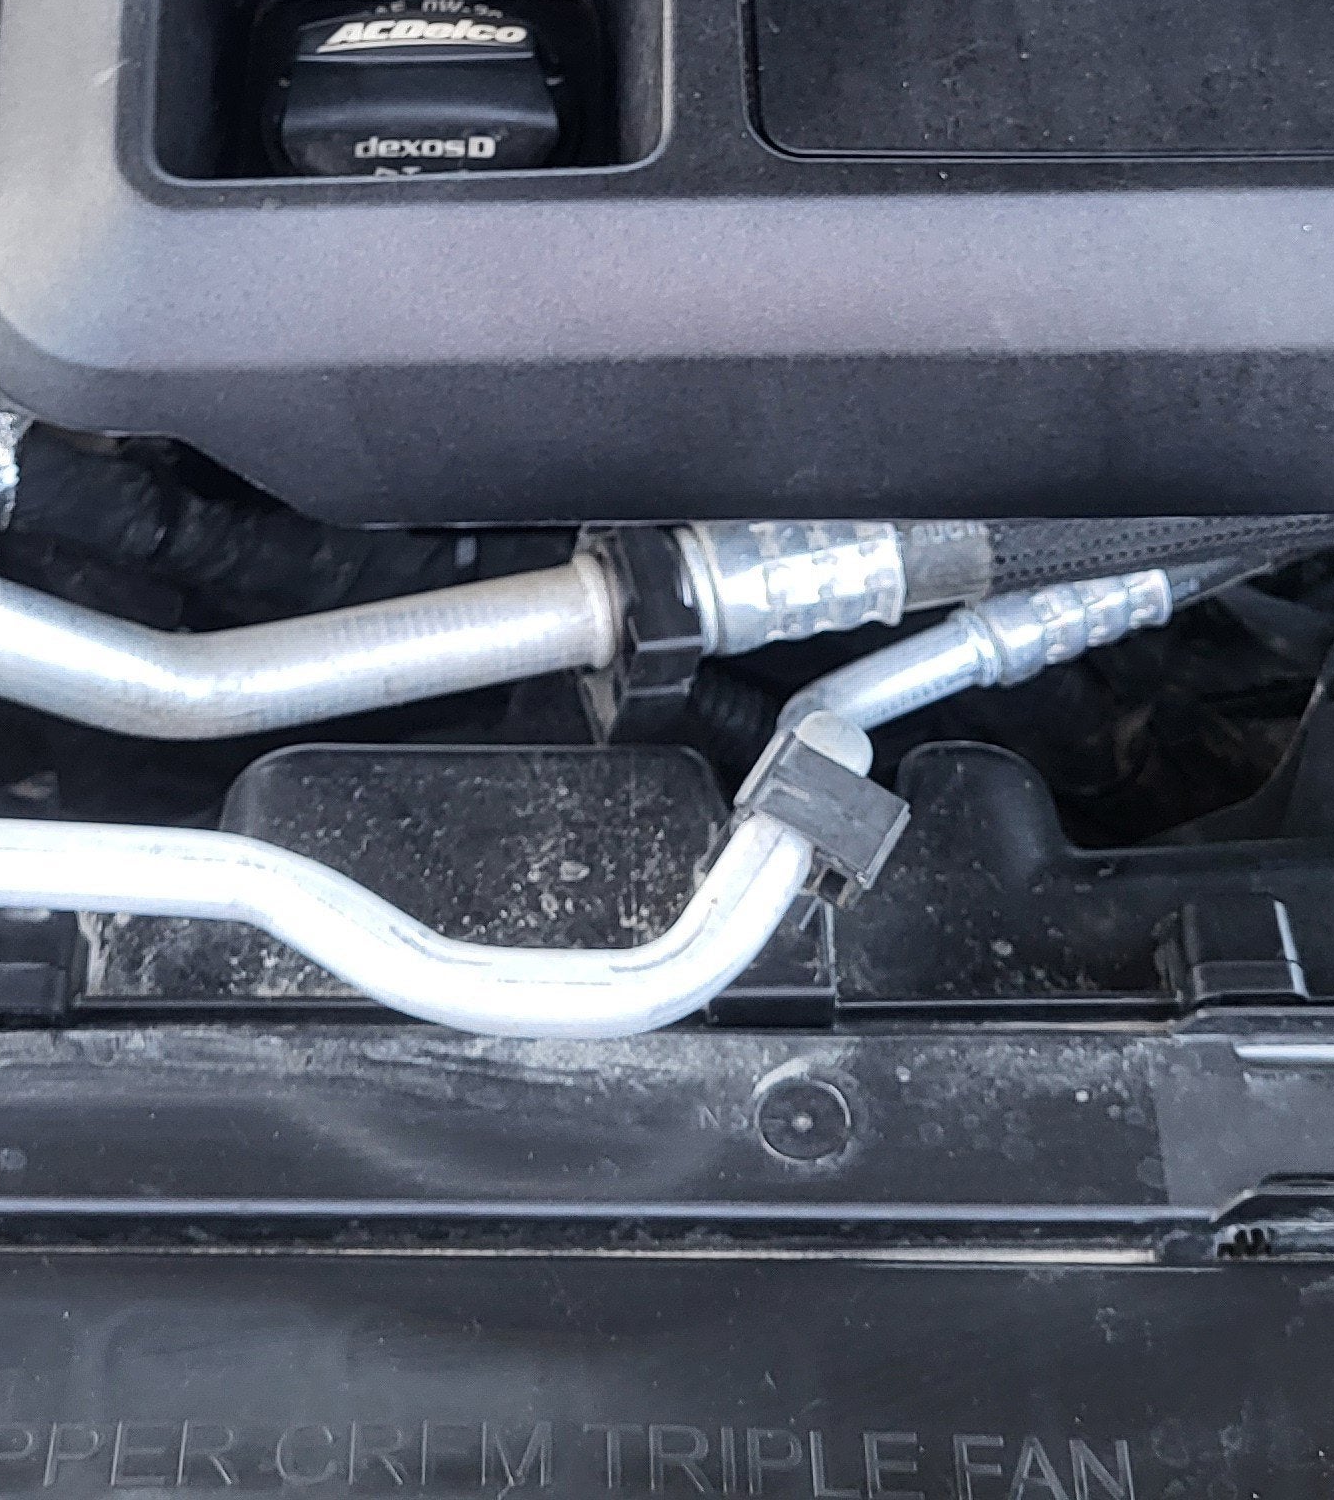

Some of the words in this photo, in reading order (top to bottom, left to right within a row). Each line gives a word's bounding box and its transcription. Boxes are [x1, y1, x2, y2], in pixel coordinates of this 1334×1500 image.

[321, 18, 528, 46] ACDelco
[353, 134, 497, 159] dexosD
[276, 1420, 552, 1487] CRFM
[583, 1423, 926, 1499] TRIPLE
[953, 1434, 1135, 1500] FAN
